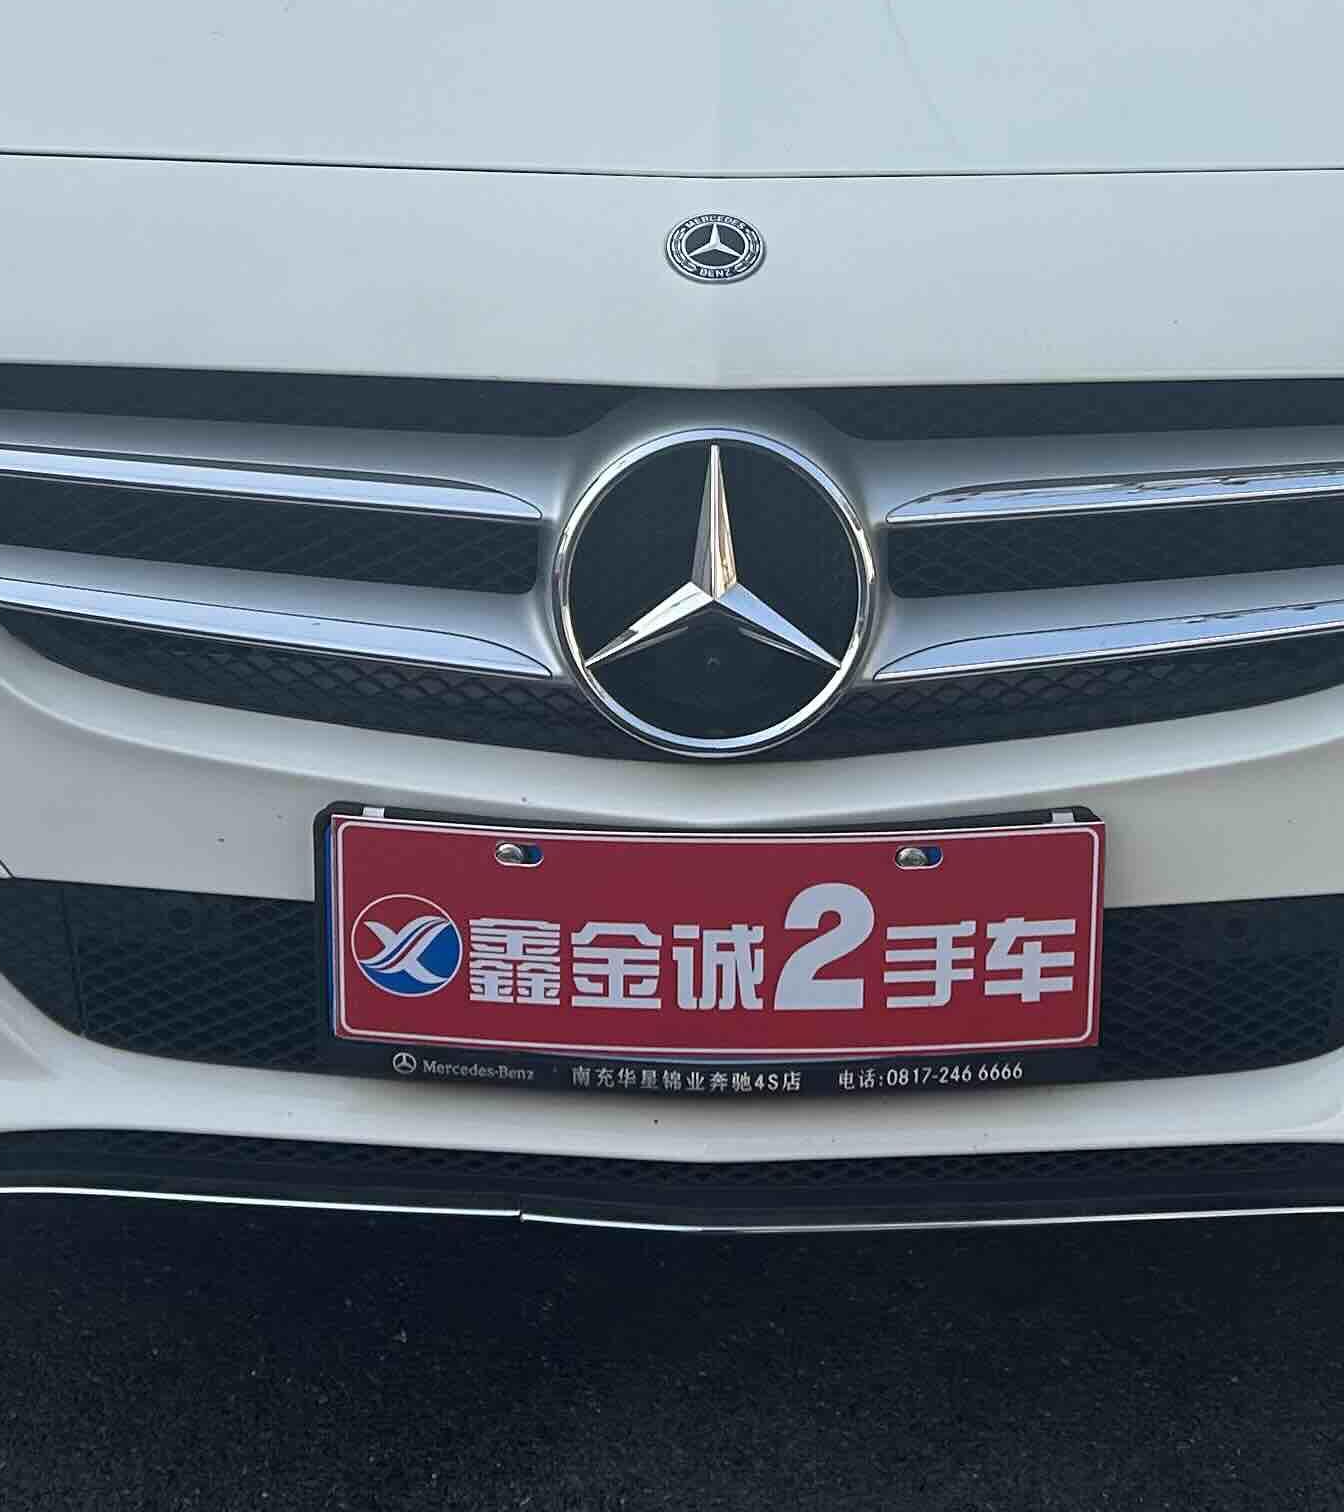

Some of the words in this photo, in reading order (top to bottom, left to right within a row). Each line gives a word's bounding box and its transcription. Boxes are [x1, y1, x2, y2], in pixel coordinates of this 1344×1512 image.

[468, 882, 1076, 1011] 鑫金诚2手车
[422, 1059, 534, 1081] Mercedes-Benz
[978, 1061, 1023, 1082] 6666
